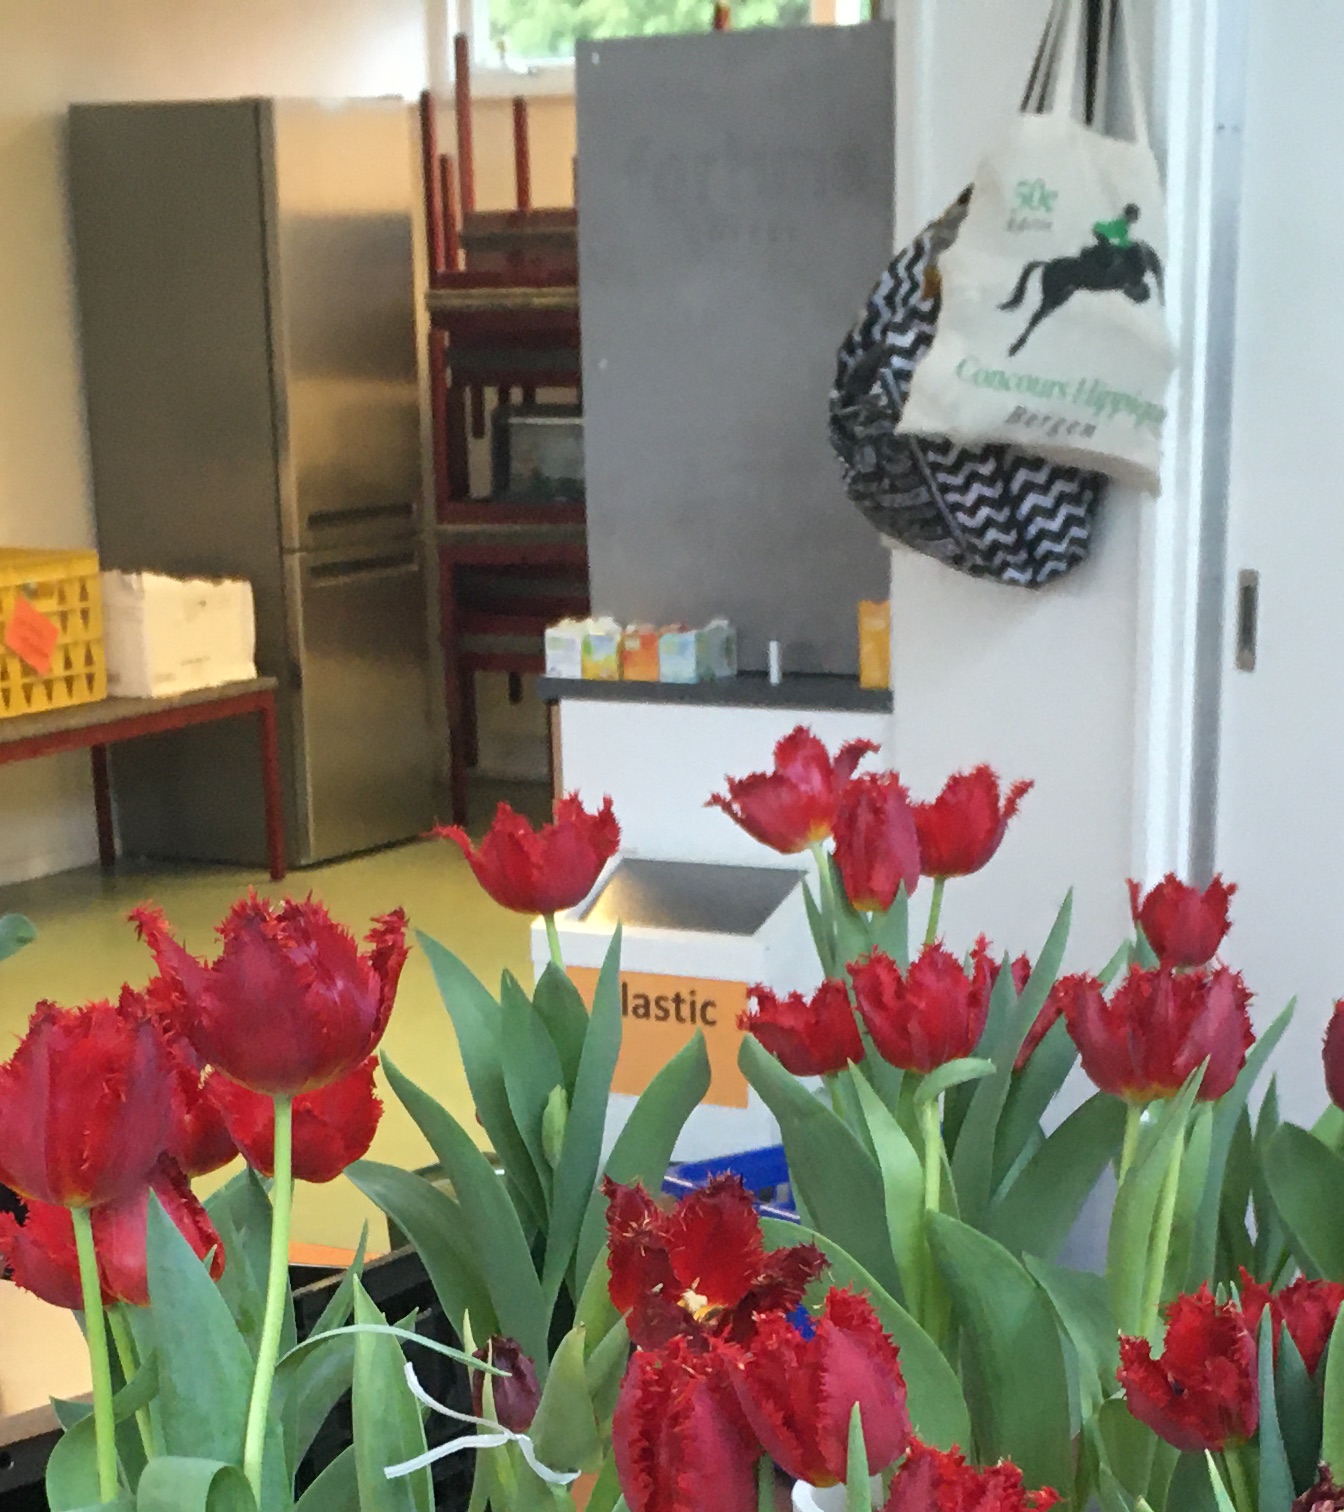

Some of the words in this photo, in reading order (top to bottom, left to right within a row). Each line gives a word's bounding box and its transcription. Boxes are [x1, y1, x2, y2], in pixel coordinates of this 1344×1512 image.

[956, 356, 1067, 398] Concours
[1006, 405, 1097, 437] Bergen
[620, 981, 718, 1026] lastic
